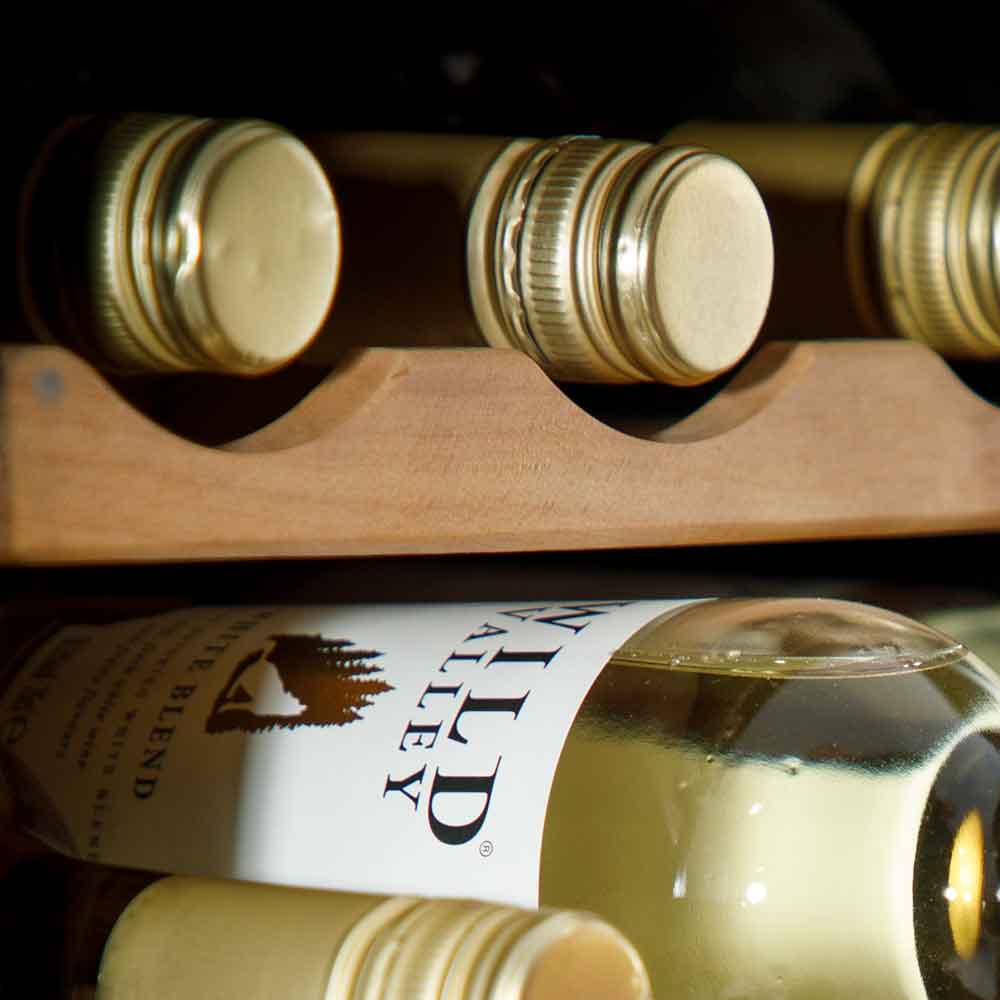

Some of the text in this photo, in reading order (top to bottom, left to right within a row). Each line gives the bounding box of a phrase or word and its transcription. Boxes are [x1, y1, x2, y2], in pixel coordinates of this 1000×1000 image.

[132, 684, 198, 799] BLEND
[383, 606, 552, 812] VALLEY
[428, 600, 641, 845] WILD
